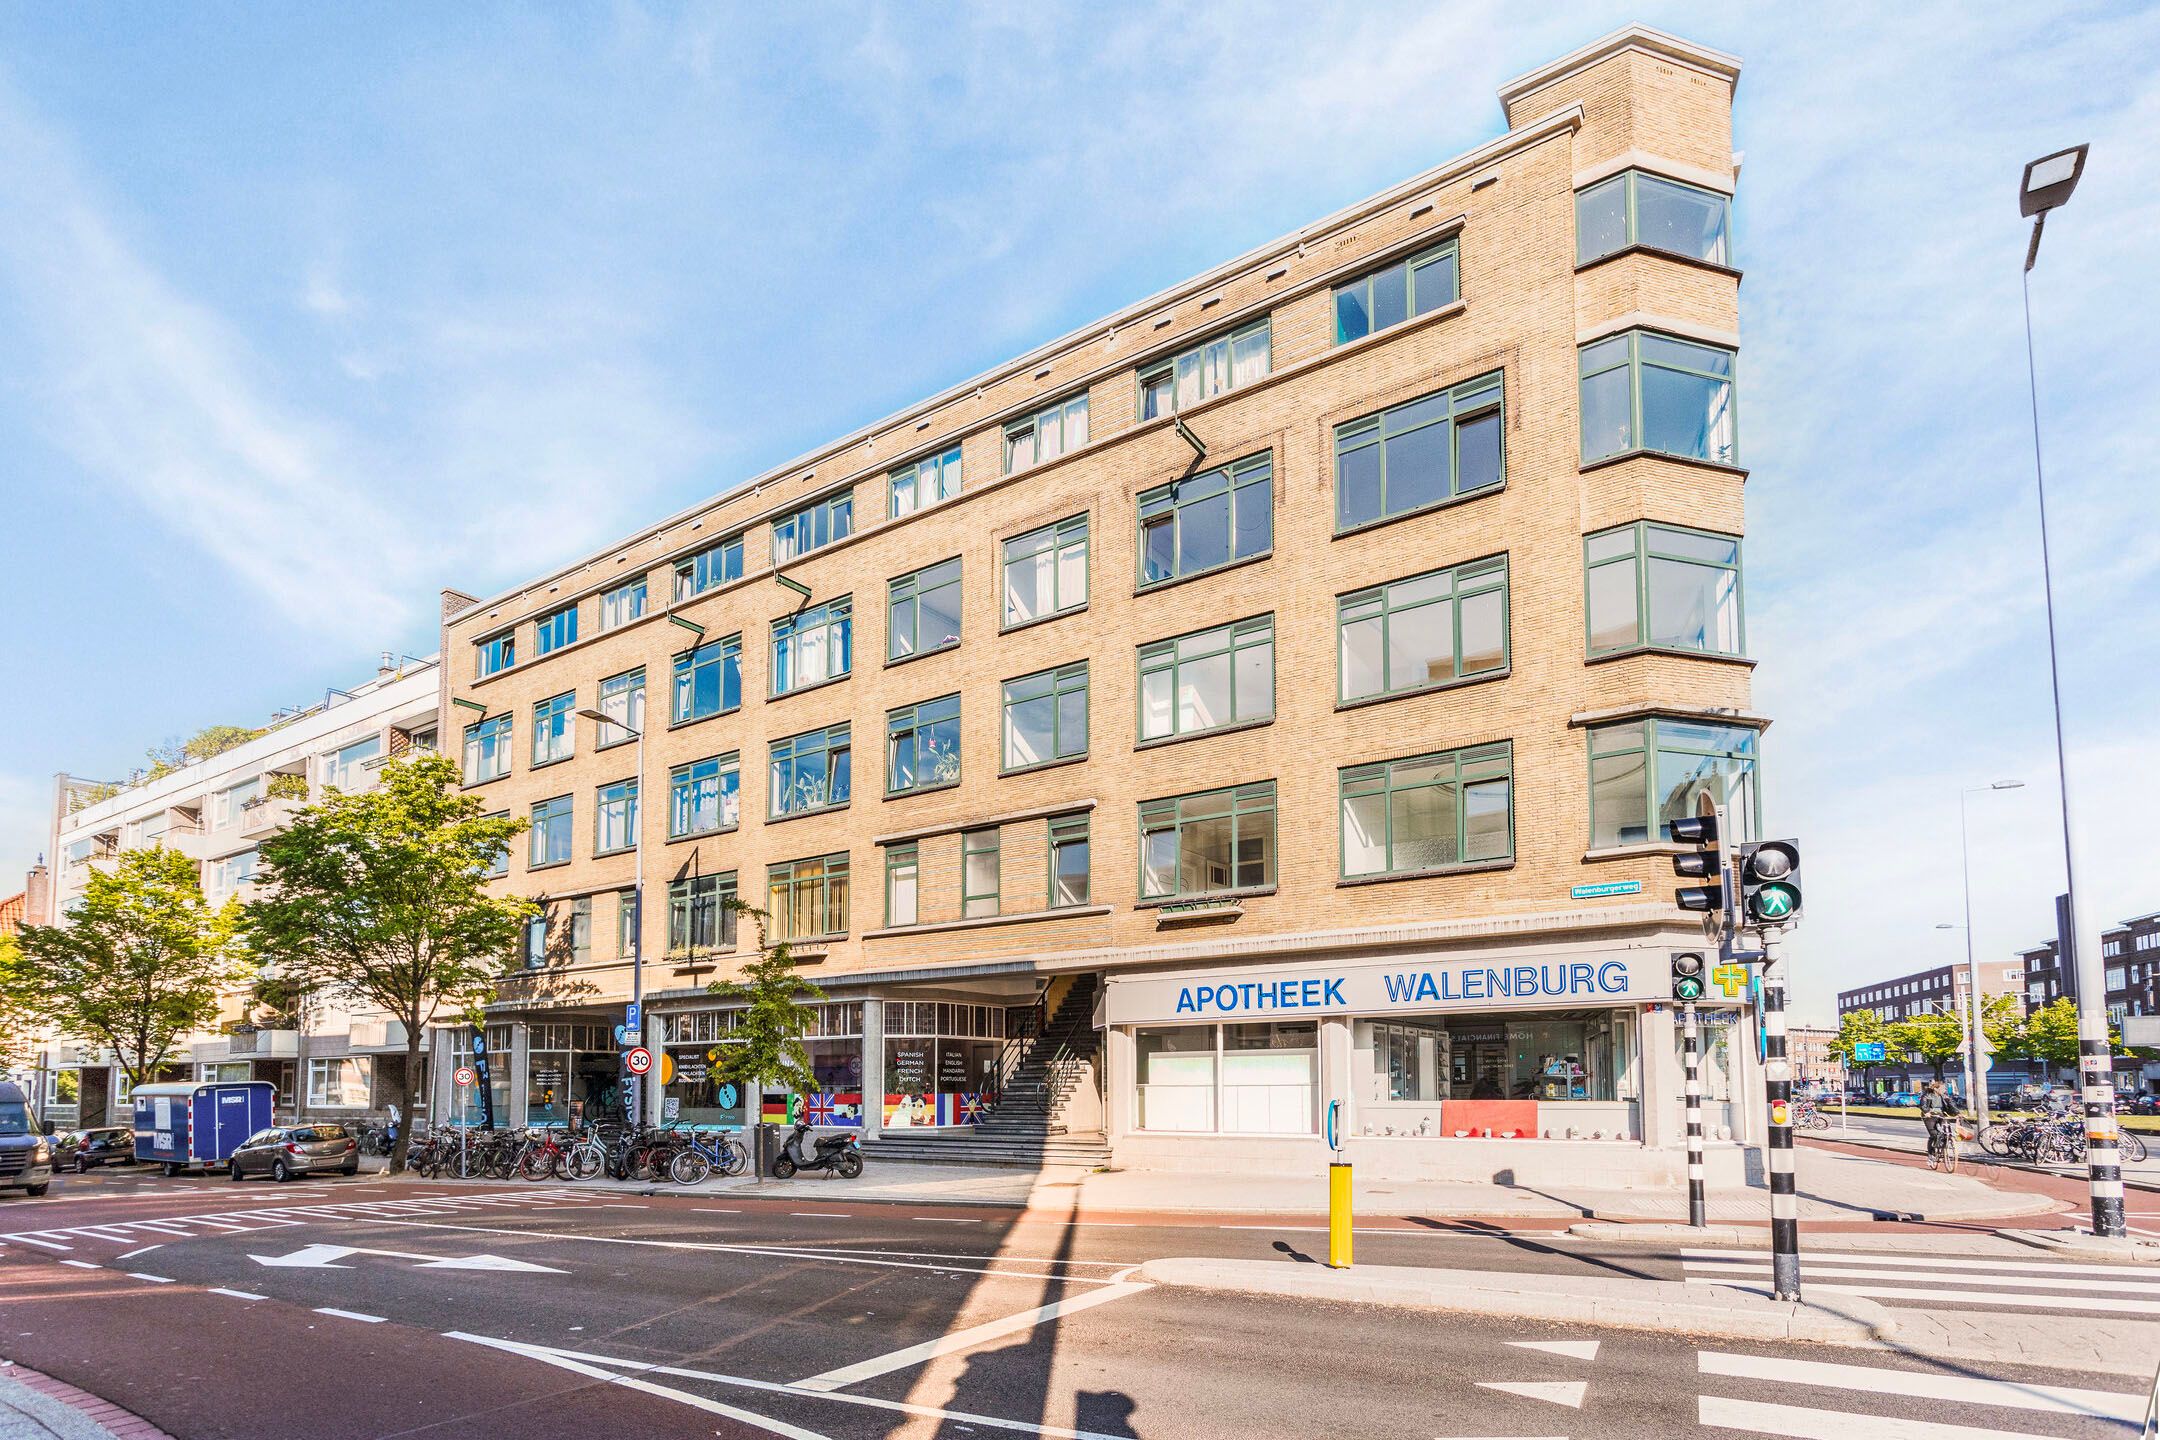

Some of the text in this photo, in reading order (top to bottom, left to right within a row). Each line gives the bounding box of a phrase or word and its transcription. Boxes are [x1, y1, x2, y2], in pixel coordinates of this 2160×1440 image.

[1575, 883, 1639, 895] Walenburgerweg
[1176, 961, 1628, 1013] APOTHEEK WALENBURG
[629, 1007, 636, 1020] P
[1674, 1012, 1738, 1024] APTHEEK
[632, 1055, 648, 1066] 30
